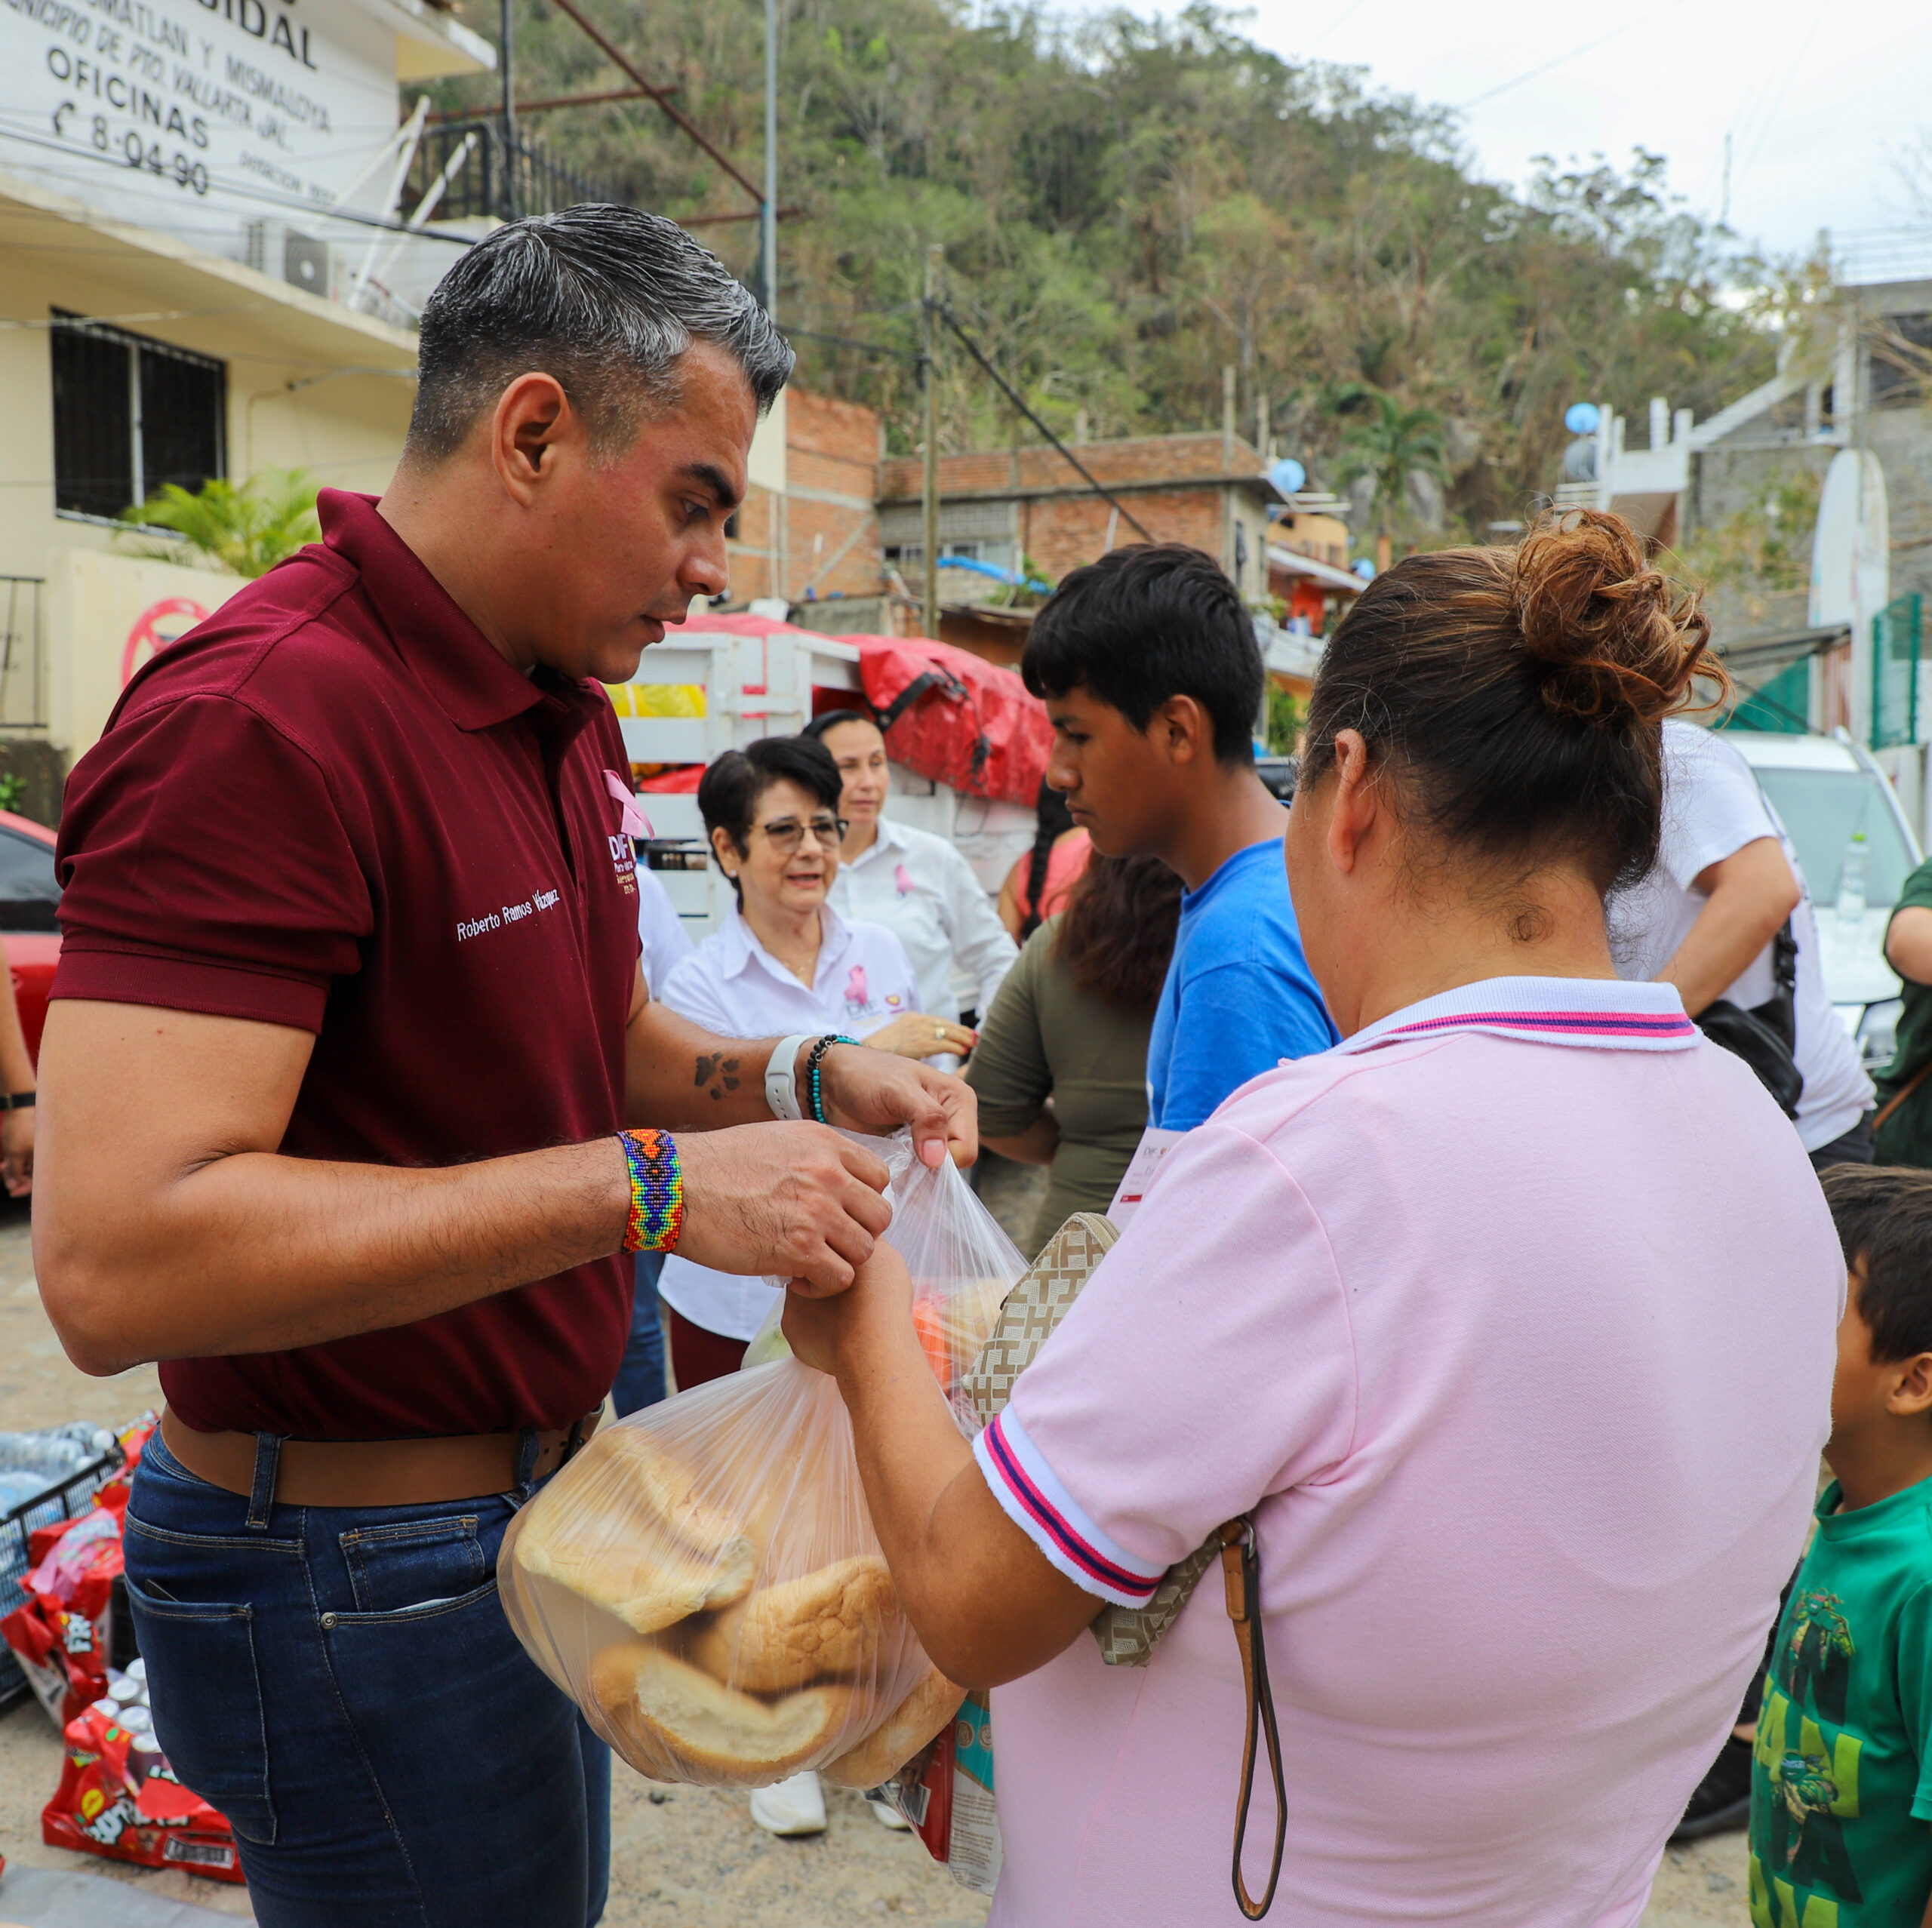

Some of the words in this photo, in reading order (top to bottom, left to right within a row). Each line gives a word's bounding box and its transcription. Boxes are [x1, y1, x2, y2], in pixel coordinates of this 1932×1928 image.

[6, 0, 91, 45] NICIPIO
[95, 23, 122, 63] DE
[172, 62, 253, 130] VALLARTA
[198, 0, 316, 71] IDAL
[198, 35, 214, 71] Y
[225, 51, 333, 134] MISMALOYA
[47, 47, 209, 148] OFICINAS
[456, 912, 500, 942] Roberto
[501, 900, 533, 925] Ramos
[531, 888, 560, 912] Vázquez
